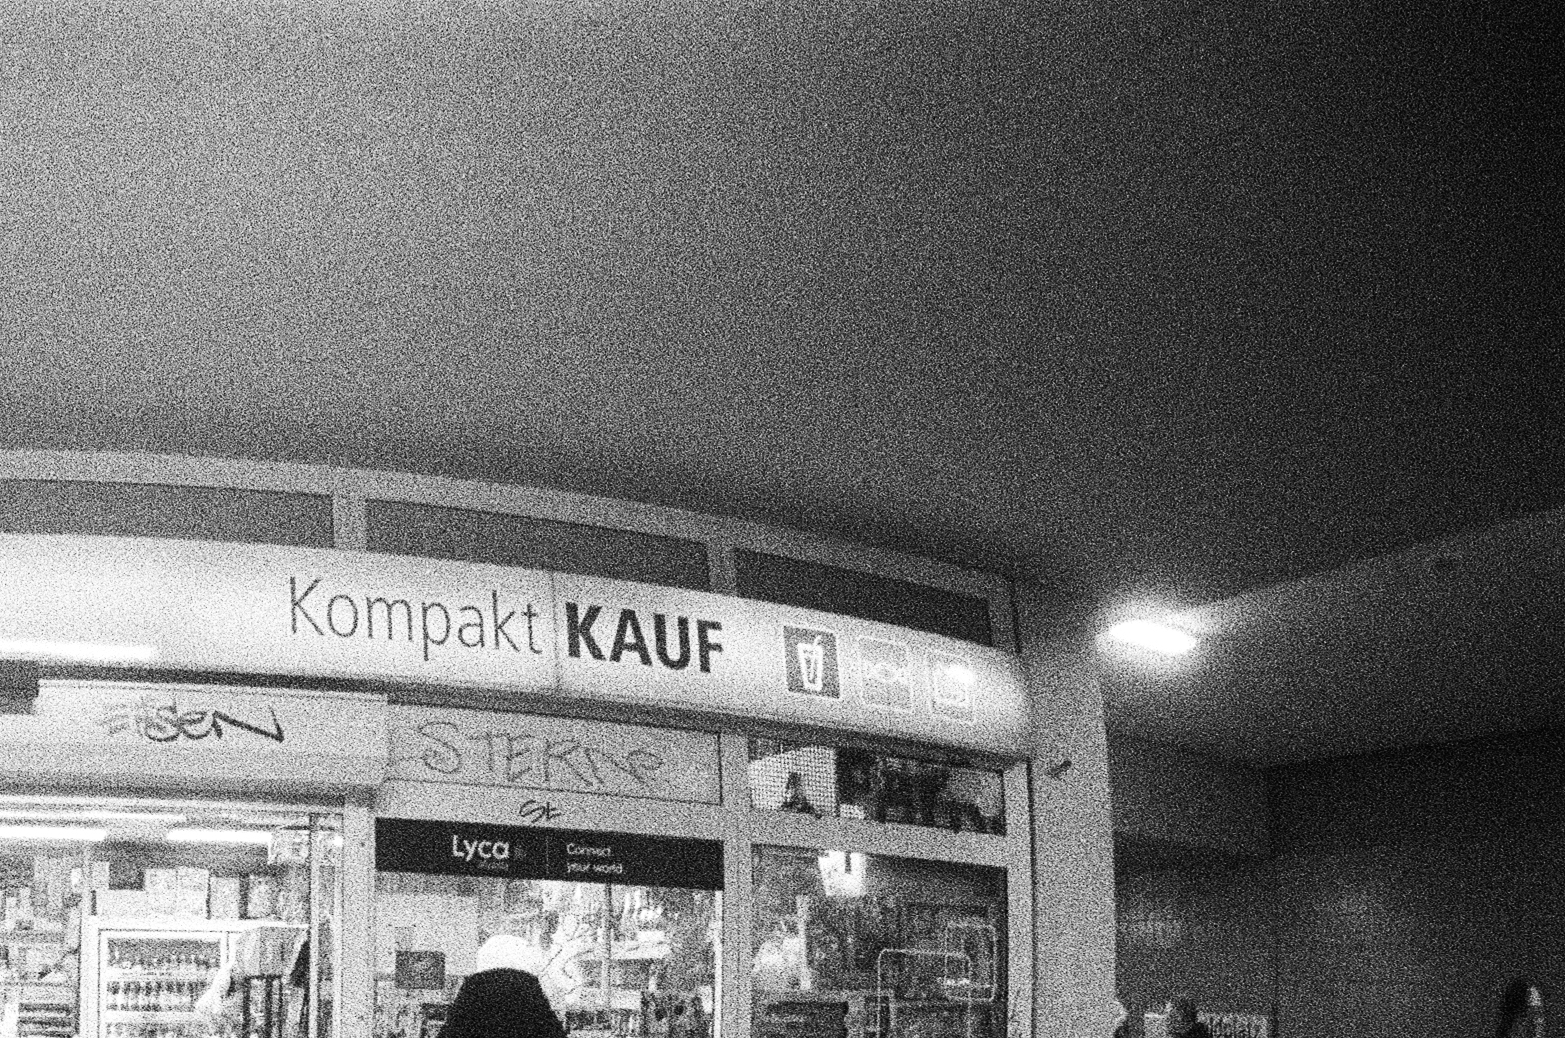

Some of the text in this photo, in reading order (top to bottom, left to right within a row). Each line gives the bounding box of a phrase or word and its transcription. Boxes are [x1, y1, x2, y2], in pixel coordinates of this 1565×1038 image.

[289, 576, 724, 673] Kompakt KAUF
[451, 835, 510, 861] Lyca
[566, 842, 612, 857] Connect
[566, 861, 624, 875] your world
